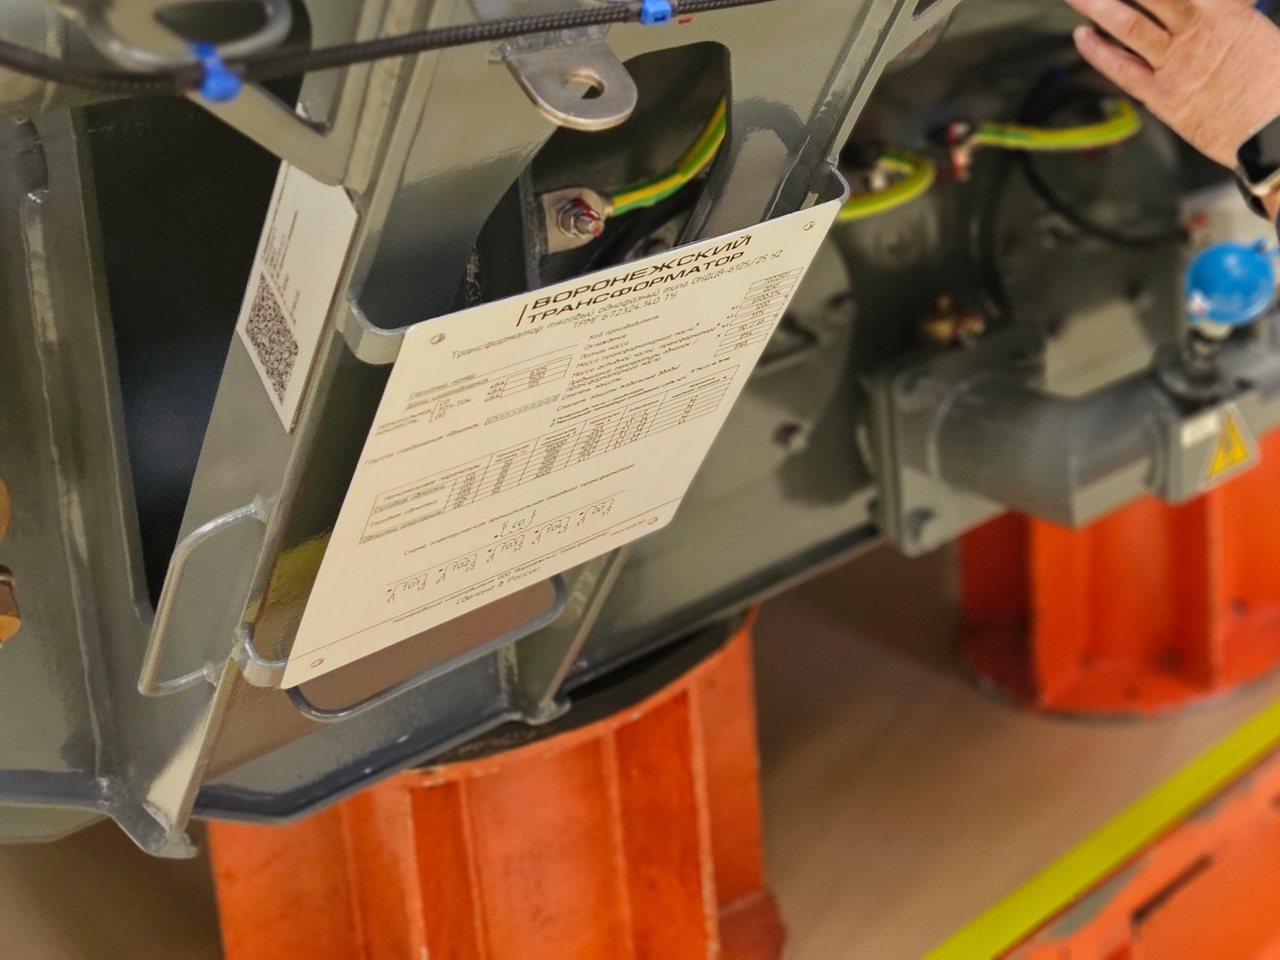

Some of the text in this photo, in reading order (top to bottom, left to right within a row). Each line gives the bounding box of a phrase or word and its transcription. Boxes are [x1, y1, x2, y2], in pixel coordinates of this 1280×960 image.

[524, 250, 744, 325] ТРАНСФОРМАТОР
[531, 233, 753, 309] ВОРОНЕЖСКИЙ
[663, 290, 678, 301] ТУ
[449, 324, 544, 360] Трансформатор
[546, 307, 596, 329] тяговый
[597, 287, 661, 314] однофазный
[662, 280, 689, 294] типа
[454, 583, 496, 605] Сделано
[506, 565, 541, 583] России
